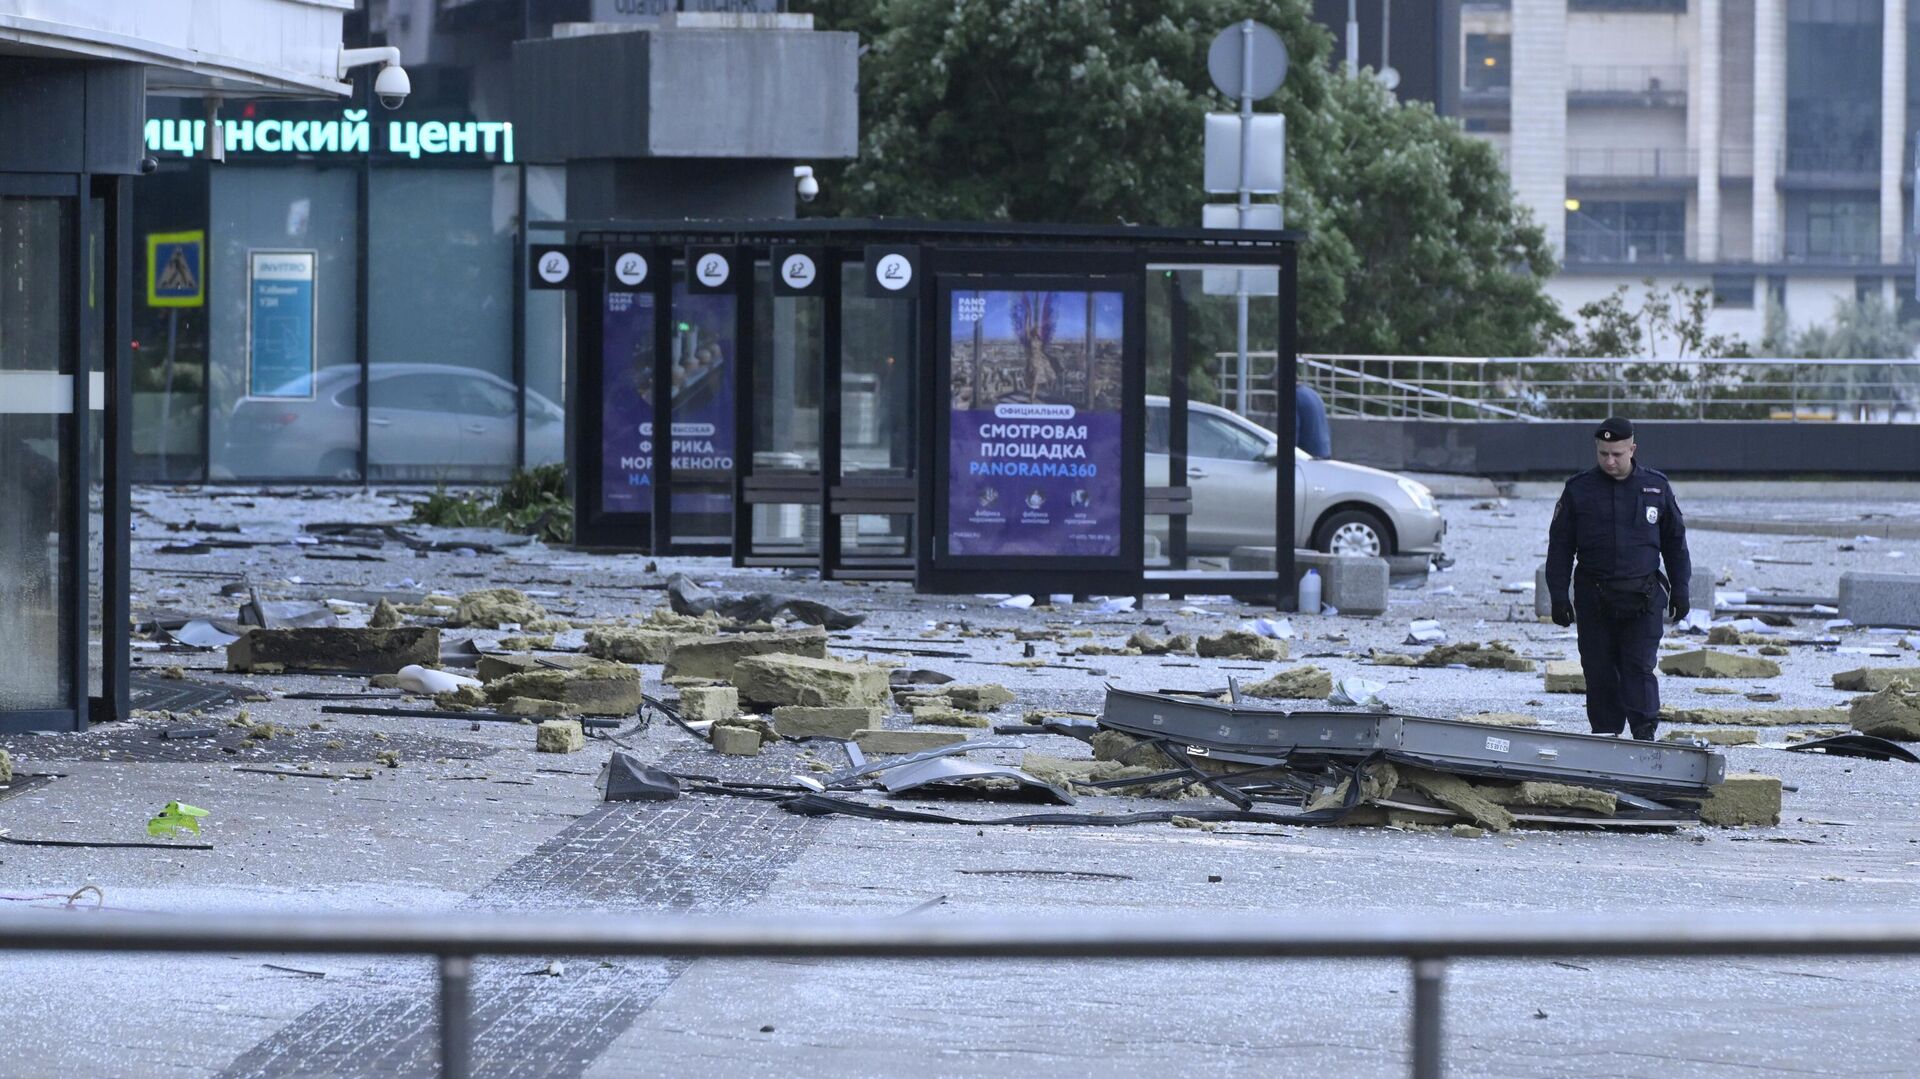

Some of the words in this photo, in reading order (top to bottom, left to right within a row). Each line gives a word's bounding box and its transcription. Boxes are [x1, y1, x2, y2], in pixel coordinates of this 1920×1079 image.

[999, 407, 1070, 416] ОФИЦИАЛЬНАЯ
[979, 423, 1088, 439] СМОТРОВАЯ
[639, 440, 714, 454] ФРИКА
[980, 442, 1087, 460] ПЛОЩАДКА
[621, 456, 734, 470] МОРЖЕНОГО
[969, 461, 1098, 477] PANORAMA360
[628, 473, 651, 486] НА
